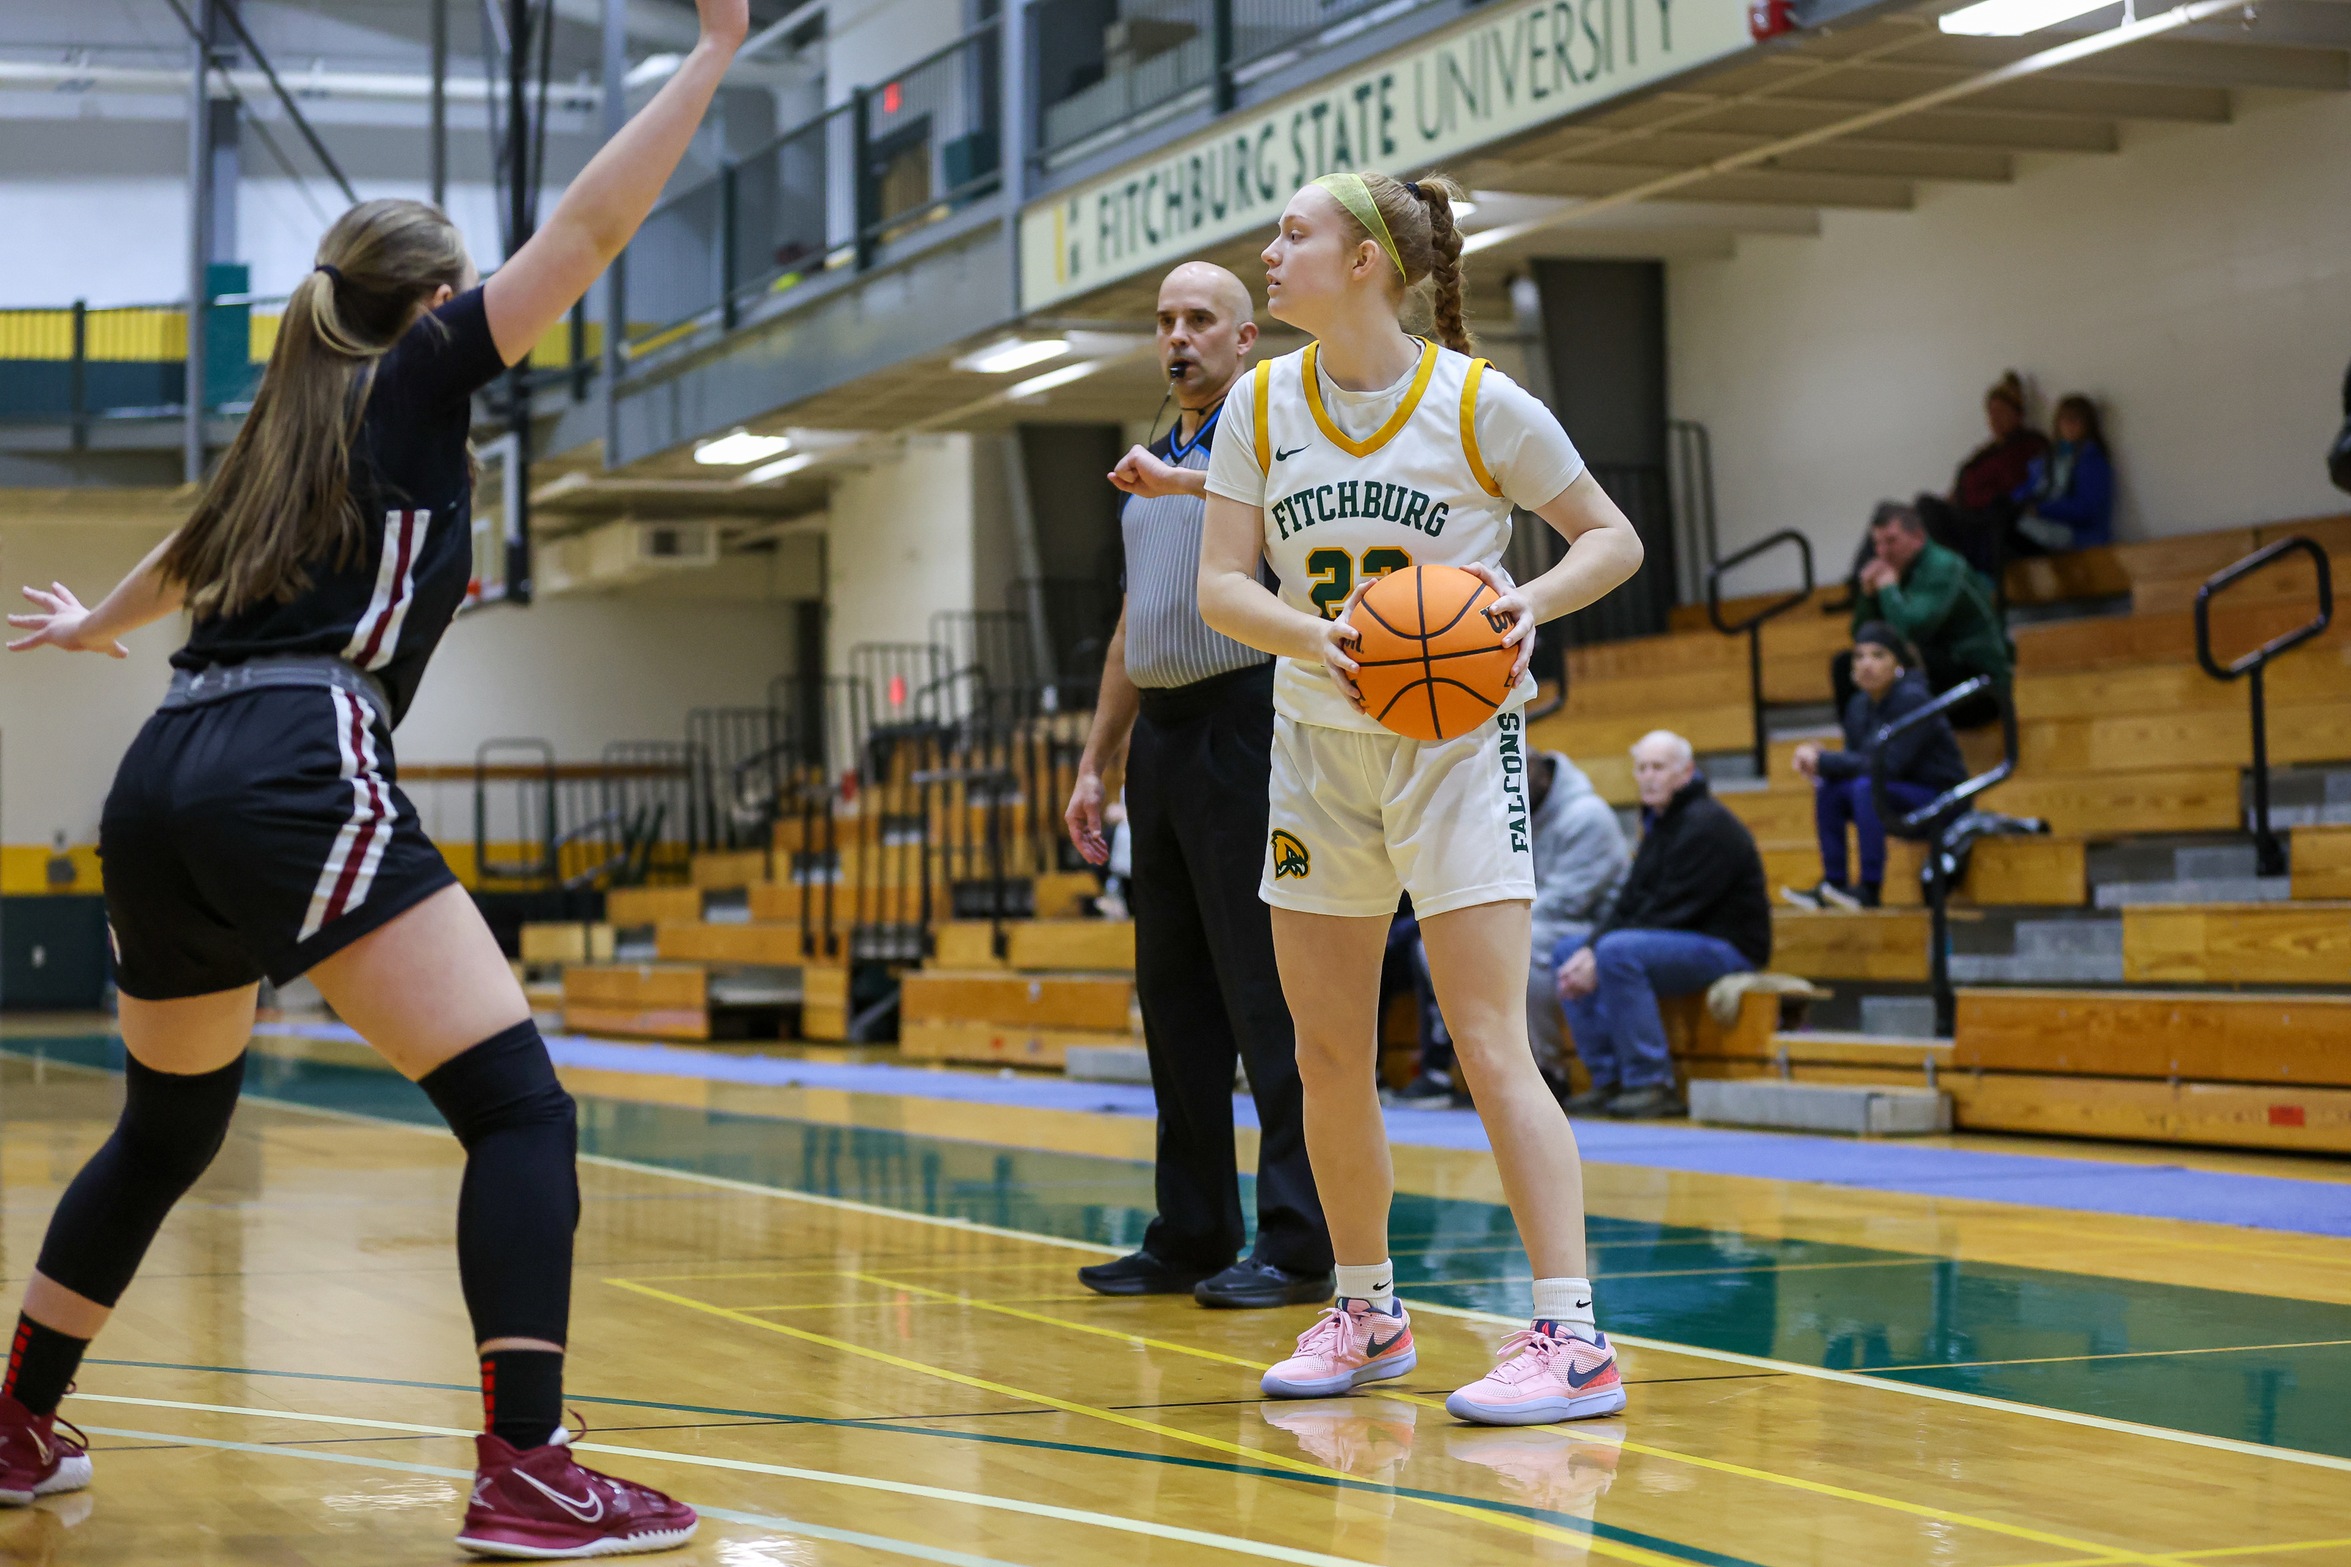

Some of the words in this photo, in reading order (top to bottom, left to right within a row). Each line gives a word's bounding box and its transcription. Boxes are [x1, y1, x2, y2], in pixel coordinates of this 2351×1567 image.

[1097, 122, 1277, 265] FITCHBURG
[1290, 72, 1395, 190] STATE
[1271, 480, 1450, 541] FITCHBURG
[1497, 712, 1529, 853] FALCONS
